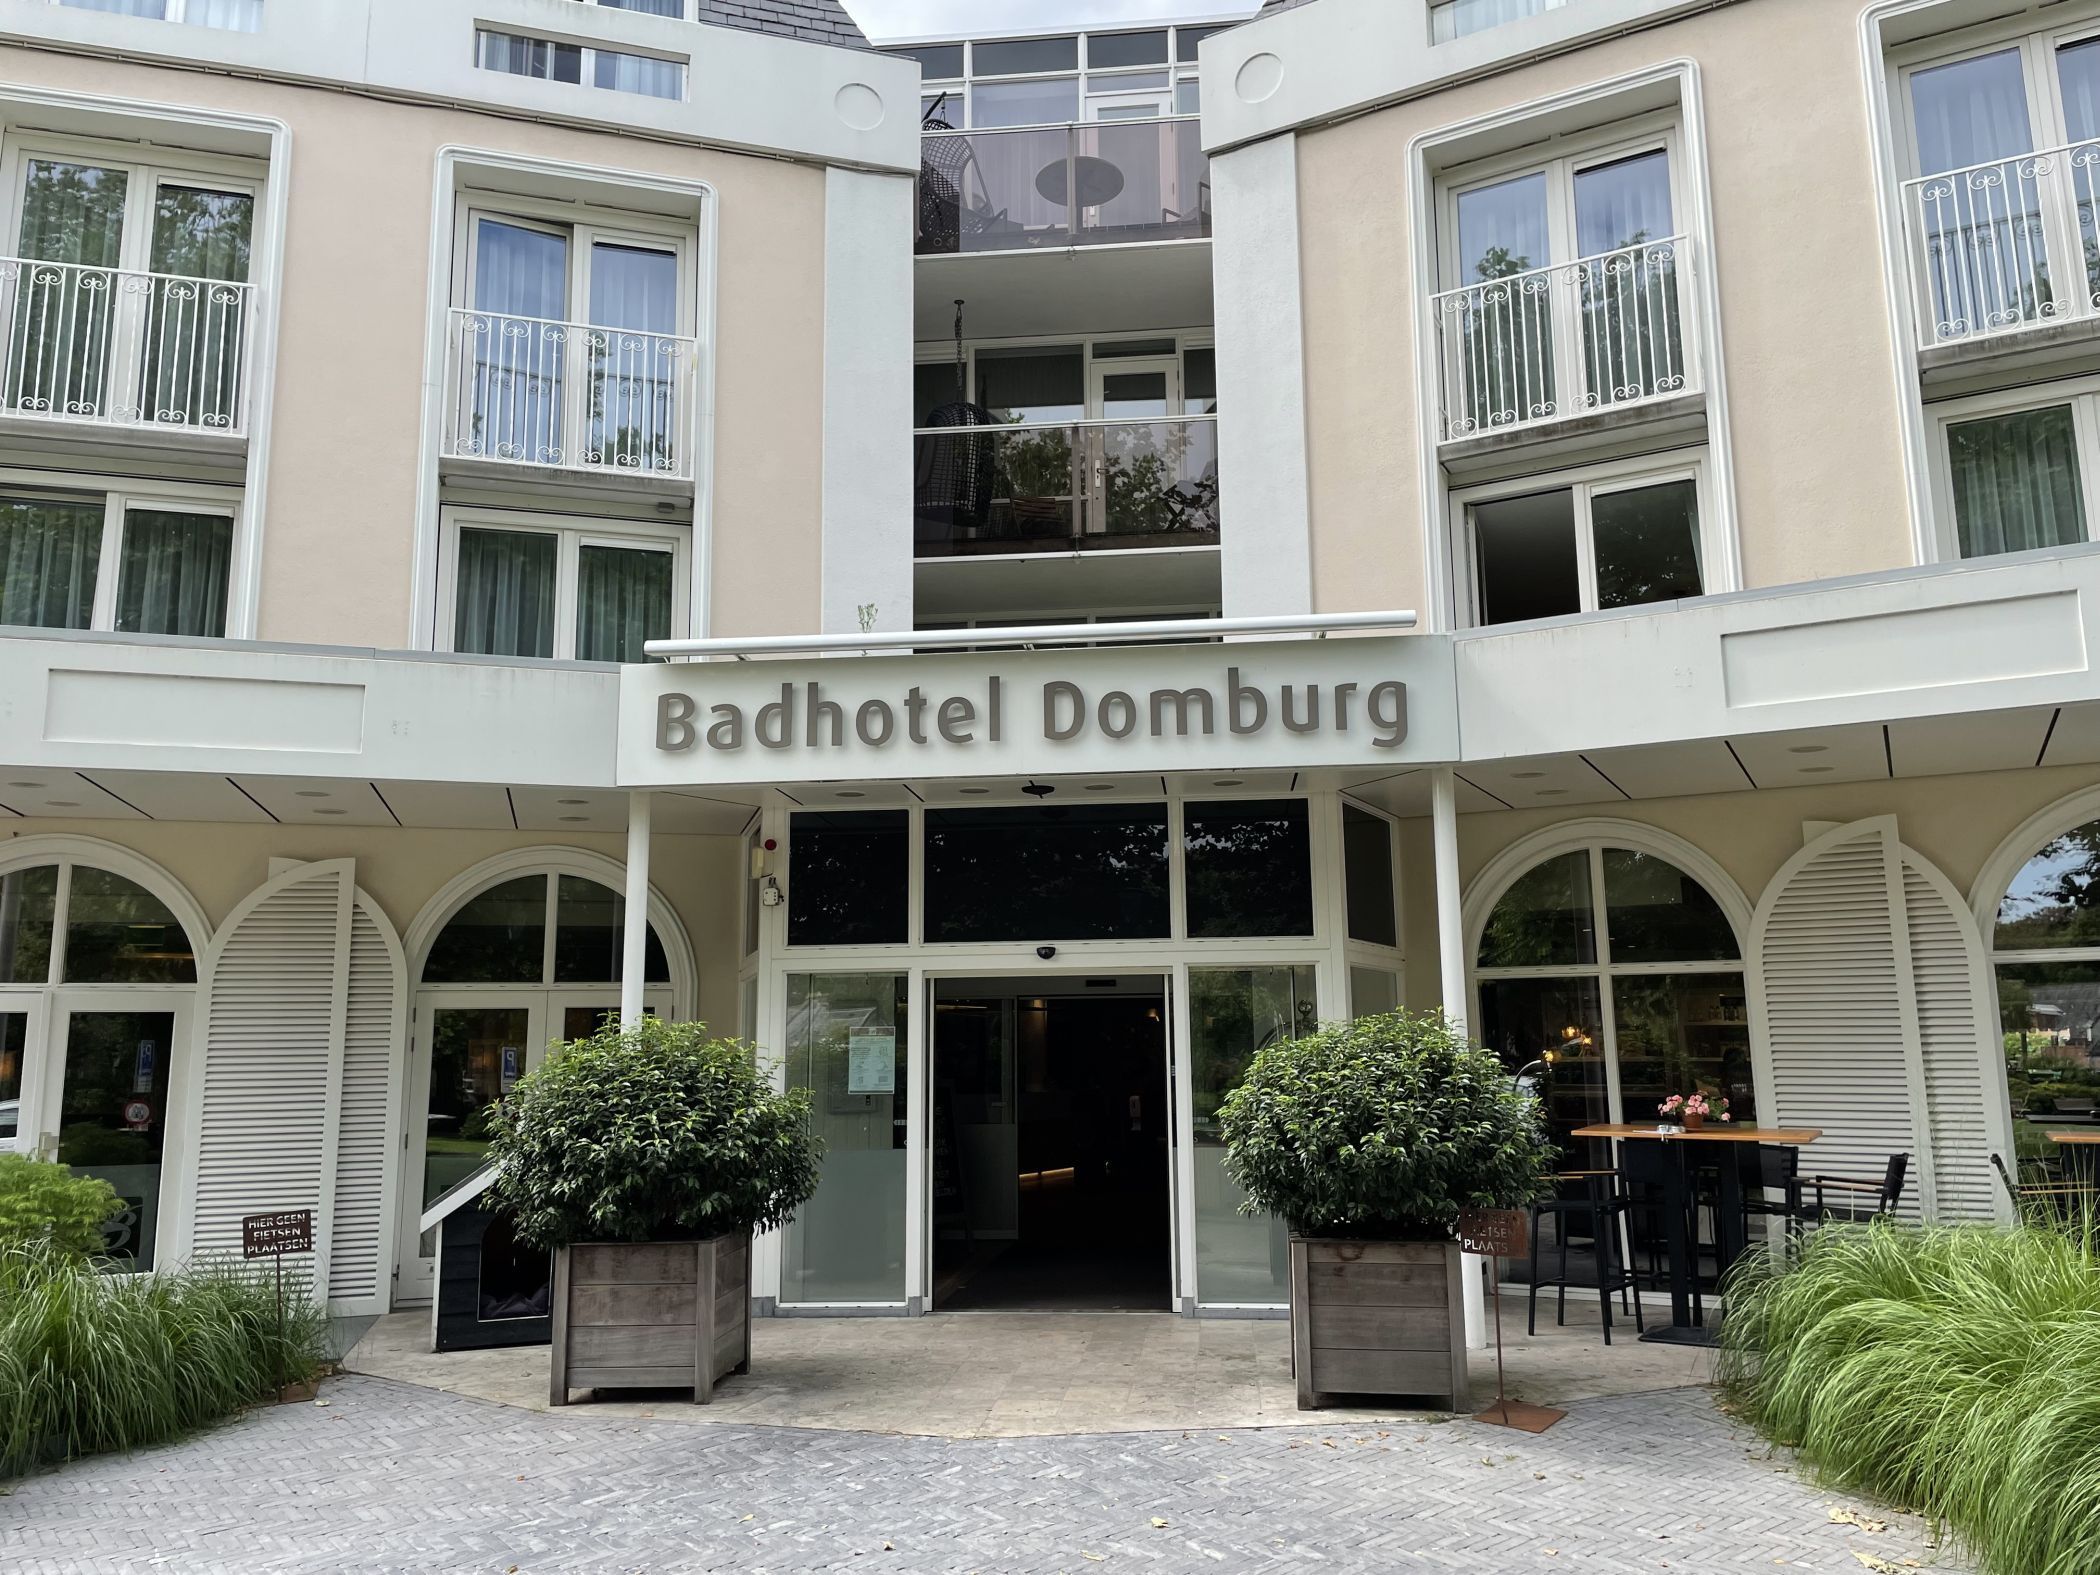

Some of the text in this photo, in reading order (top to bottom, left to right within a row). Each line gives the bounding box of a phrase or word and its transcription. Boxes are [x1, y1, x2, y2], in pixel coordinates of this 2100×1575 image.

[656, 667, 1409, 751] Badhotel Domburg
[248, 1213, 306, 1229] HIER GEEN
[253, 1227, 301, 1241] FIETSEN
[247, 1238, 308, 1254] PLAATSEN
[1464, 1239, 1518, 1253] PLAATS
